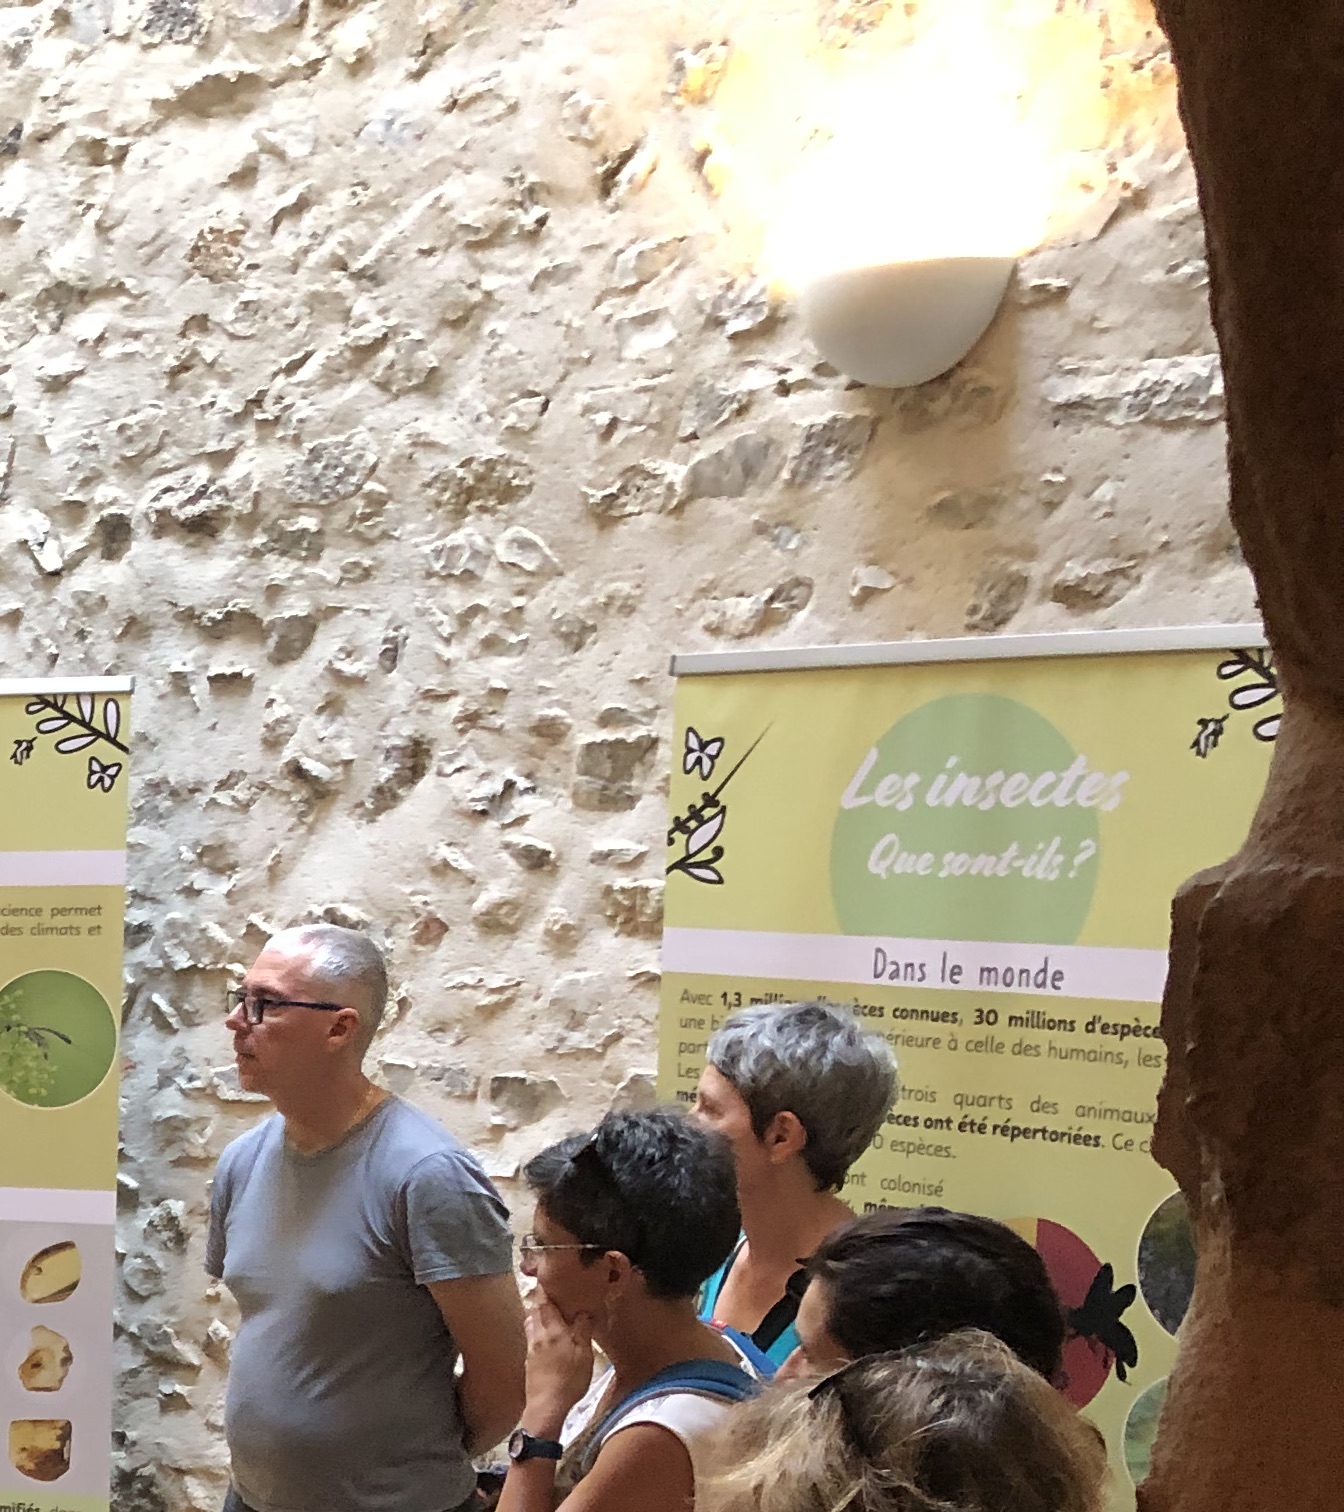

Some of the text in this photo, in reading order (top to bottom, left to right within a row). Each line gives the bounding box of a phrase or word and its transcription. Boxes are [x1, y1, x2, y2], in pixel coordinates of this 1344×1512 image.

[841, 746, 1130, 811] Les insectes
[868, 833, 1097, 881] Que sont-ils ?
[0, 923, 23, 936] des
[30, 922, 81, 937] climats
[87, 924, 103, 936] et
[50, 904, 103, 920] permet
[873, 946, 1065, 991] Dans le monde
[679, 988, 713, 1006] Avec
[720, 991, 742, 1010] 1,3
[892, 1005, 964, 1027] connues,
[973, 1007, 999, 1026] 30
[1007, 1010, 1076, 1032] millions
[679, 1017, 706, 1030] une
[883, 1027, 1162, 1068] érieure à celle des humains, les
[677, 1062, 700, 1079] Les
[901, 1084, 1156, 1124] trois quarts des animaux
[890, 1136, 957, 1159] espèces.
[923, 1115, 954, 1131] ont
[957, 1114, 989, 1134] été
[991, 1117, 1105, 1148] répertoriées.
[1112, 1133, 1135, 1152] Ce
[880, 1173, 944, 1197] colonisé
